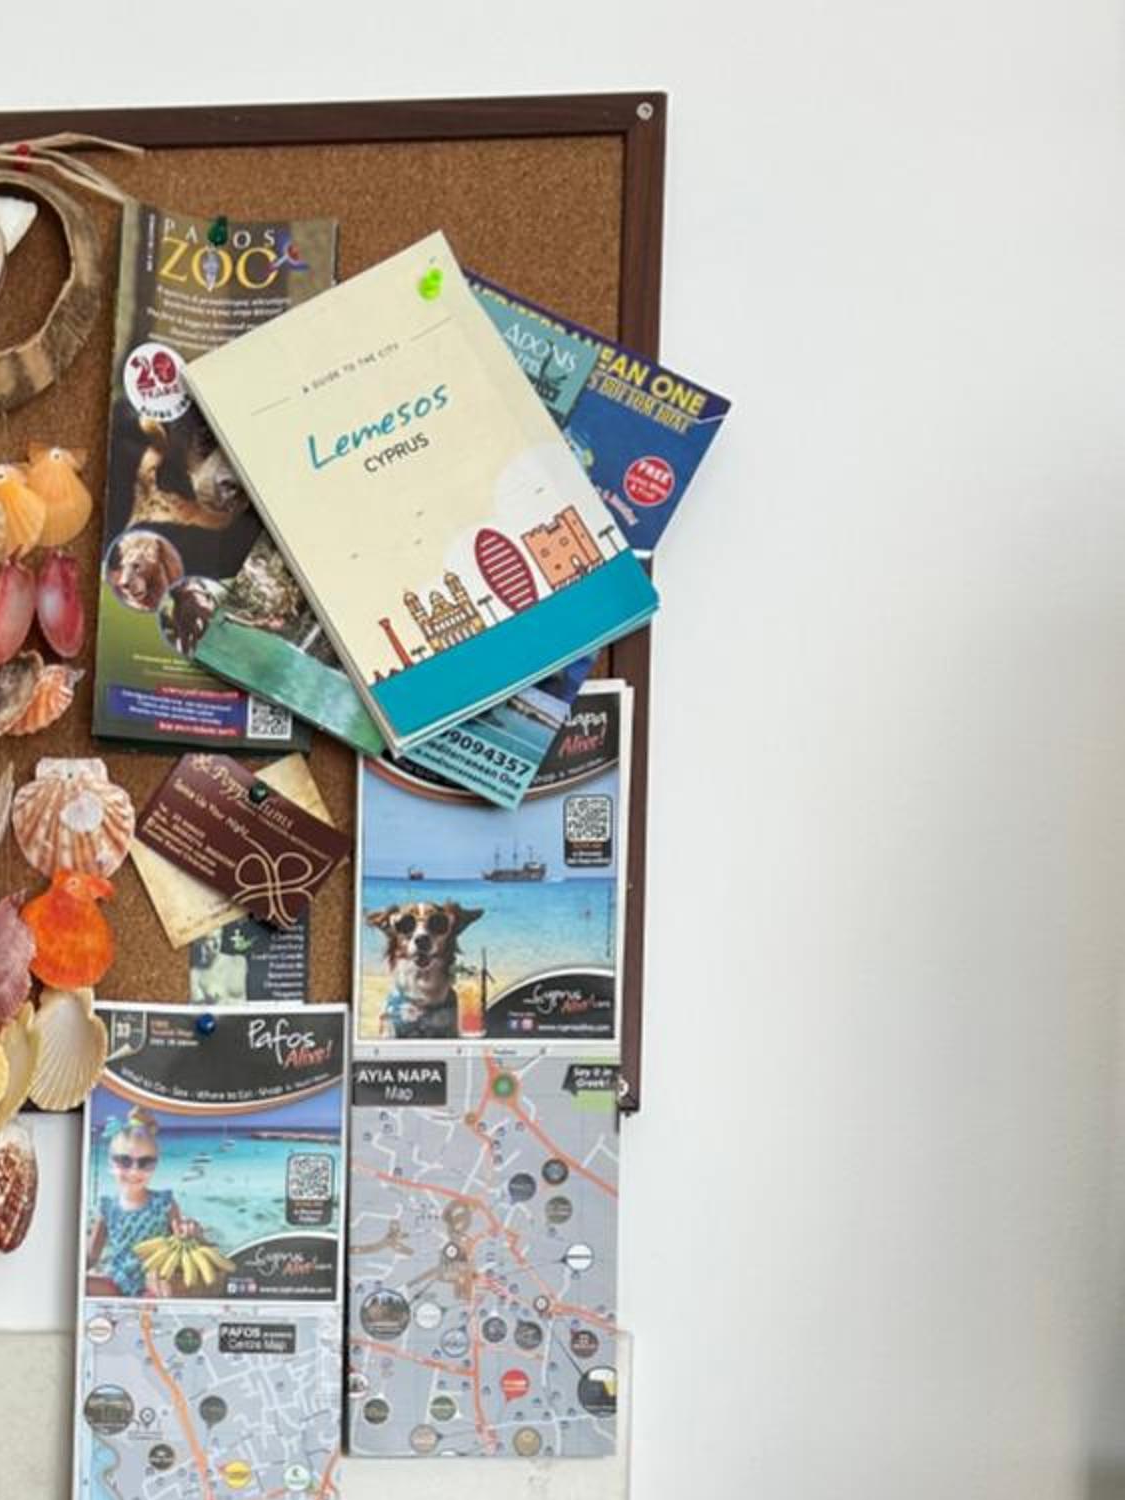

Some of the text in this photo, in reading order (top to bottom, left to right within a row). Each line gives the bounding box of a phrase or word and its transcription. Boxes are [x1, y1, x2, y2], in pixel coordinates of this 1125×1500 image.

[164, 218, 276, 249] PAOS
[130, 351, 176, 390] 20
[651, 374, 707, 414] ONE
[307, 384, 449, 470] Lemesos
[363, 432, 430, 473] CYPRUS
[249, 1018, 315, 1065] Pafos
[357, 1069, 442, 1083] AYIA NAPA
